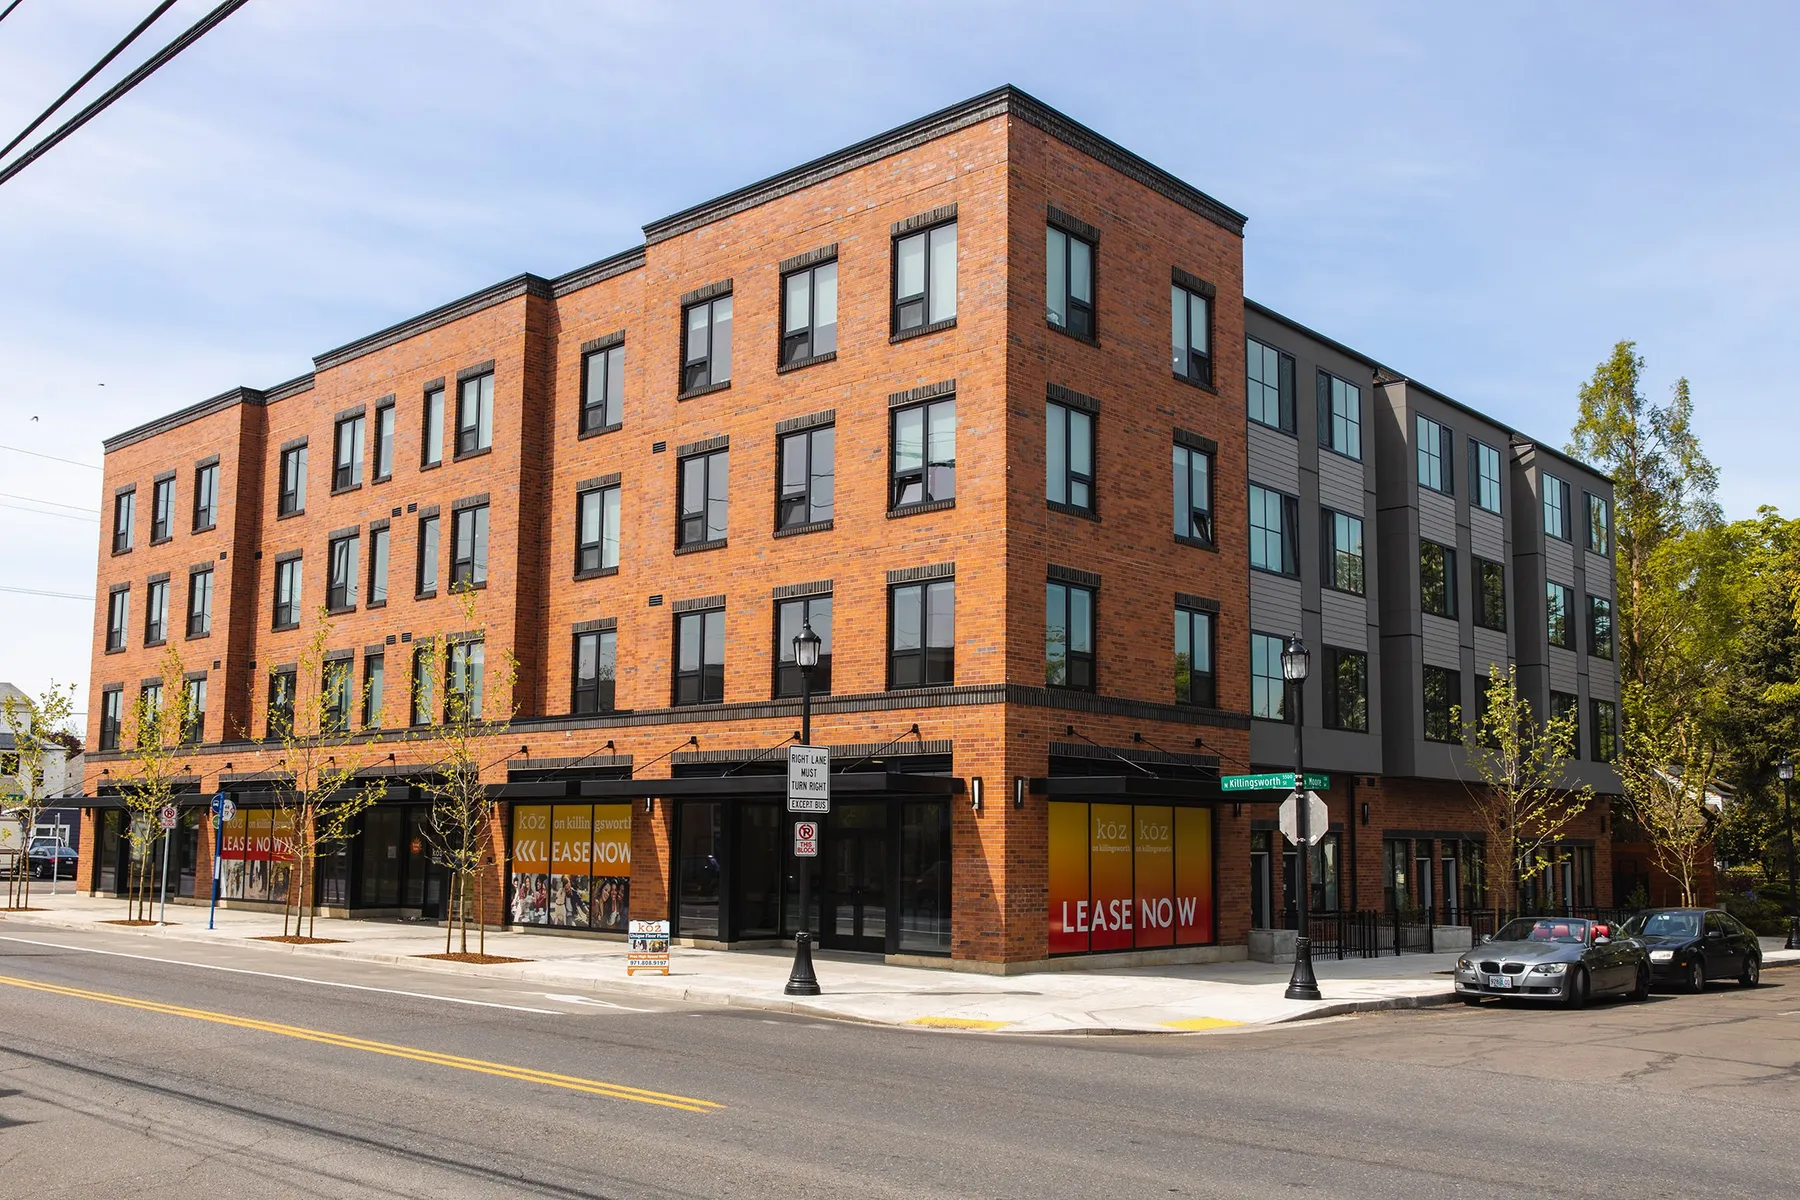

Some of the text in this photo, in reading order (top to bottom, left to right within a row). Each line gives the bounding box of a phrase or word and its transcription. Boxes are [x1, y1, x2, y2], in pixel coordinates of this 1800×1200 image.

[791, 753, 827, 765] RIGHT LANE
[801, 768, 817, 777] MUST
[791, 780, 826, 791] TURN RIGHT
[1229, 777, 1281, 788] Killingsworth
[792, 800, 813, 808] EXCEPT
[554, 820, 565, 829] on
[222, 836, 283, 852] LEASE NOW
[540, 841, 631, 863] LEASE NOW
[1063, 896, 1197, 933] LEASE NOW
